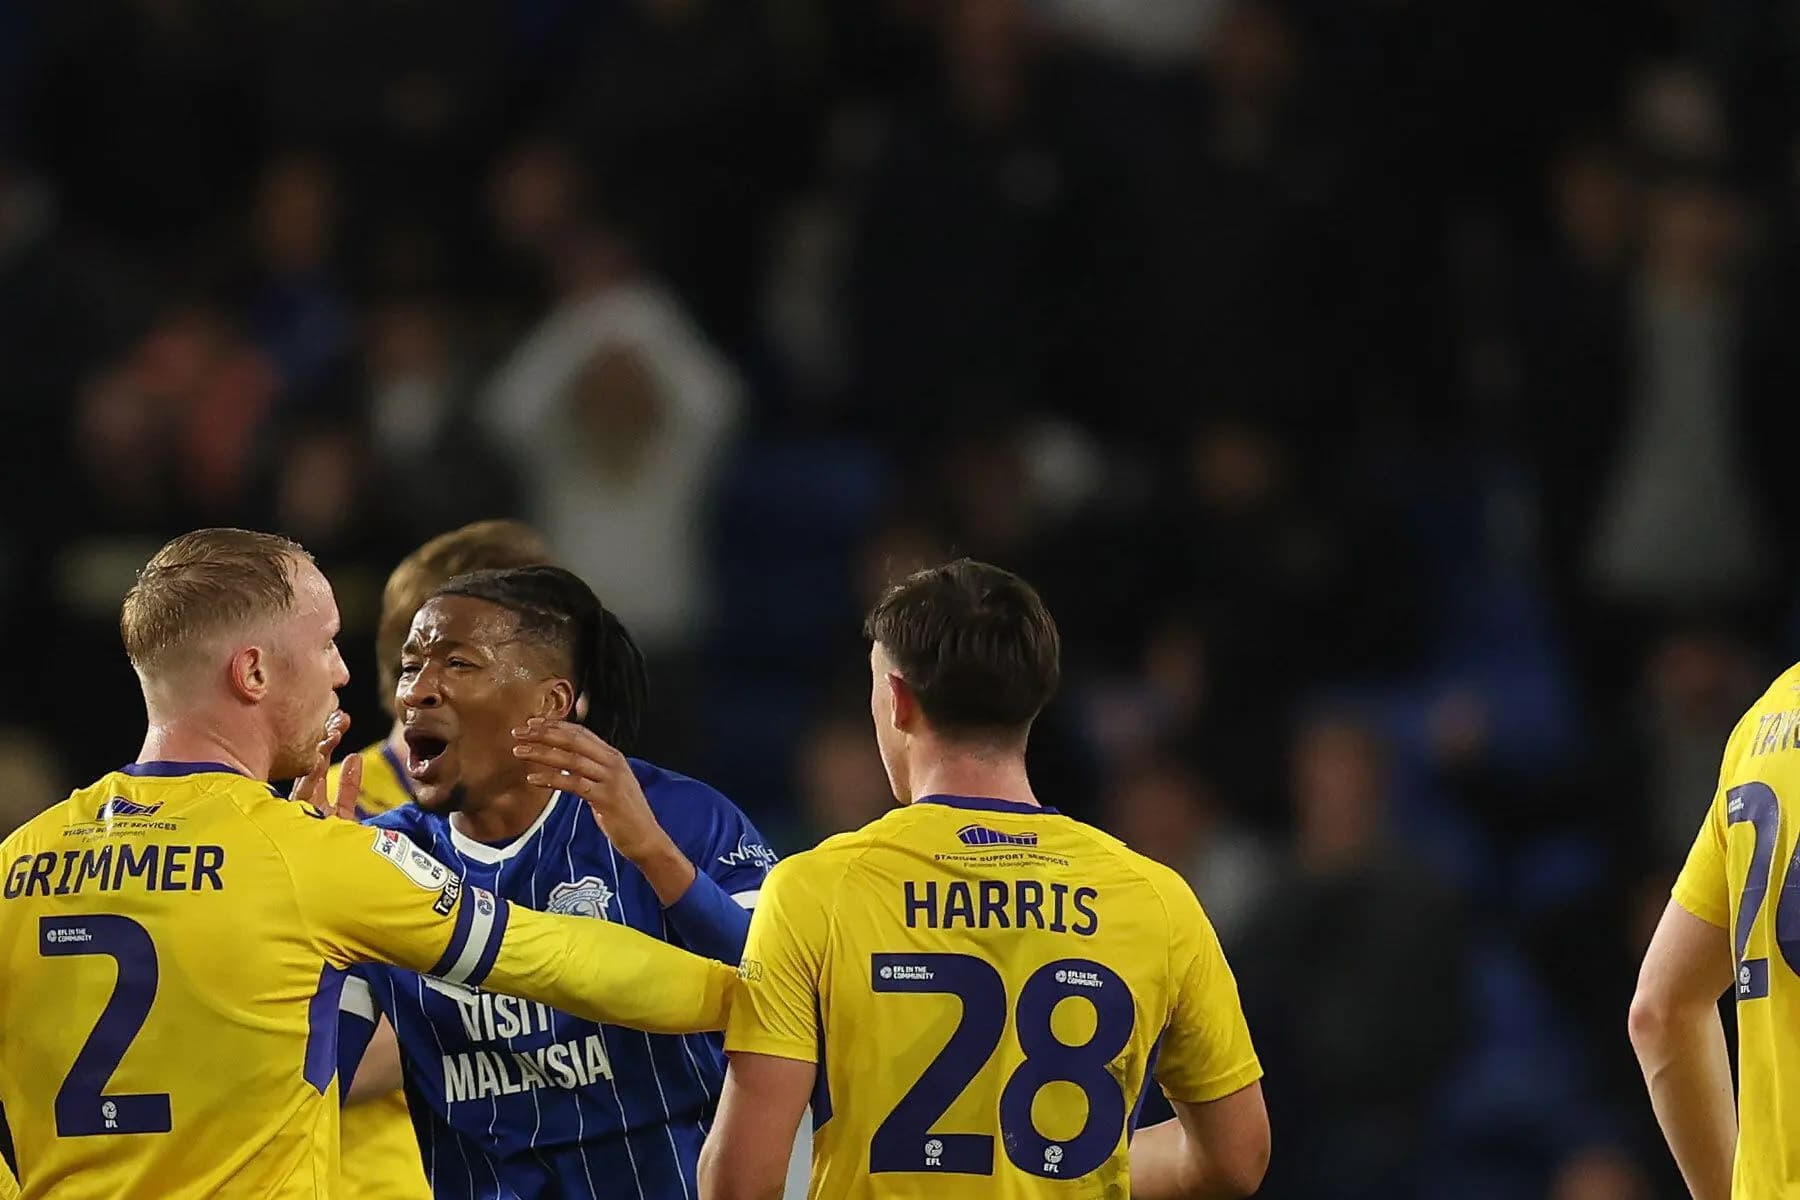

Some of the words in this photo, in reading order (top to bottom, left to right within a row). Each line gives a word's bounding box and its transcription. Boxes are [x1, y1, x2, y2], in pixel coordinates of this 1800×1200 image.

[1751, 709, 1800, 758] TAY
[3, 844, 225, 900] GRIMMER
[903, 880, 1099, 937] HARRIS
[39, 914, 173, 1138] 2
[442, 1035, 614, 1103] MALAYSIA
[869, 952, 1136, 1180] 28
[925, 1157, 942, 1166] EFL
[1043, 1163, 1059, 1173] EFL
